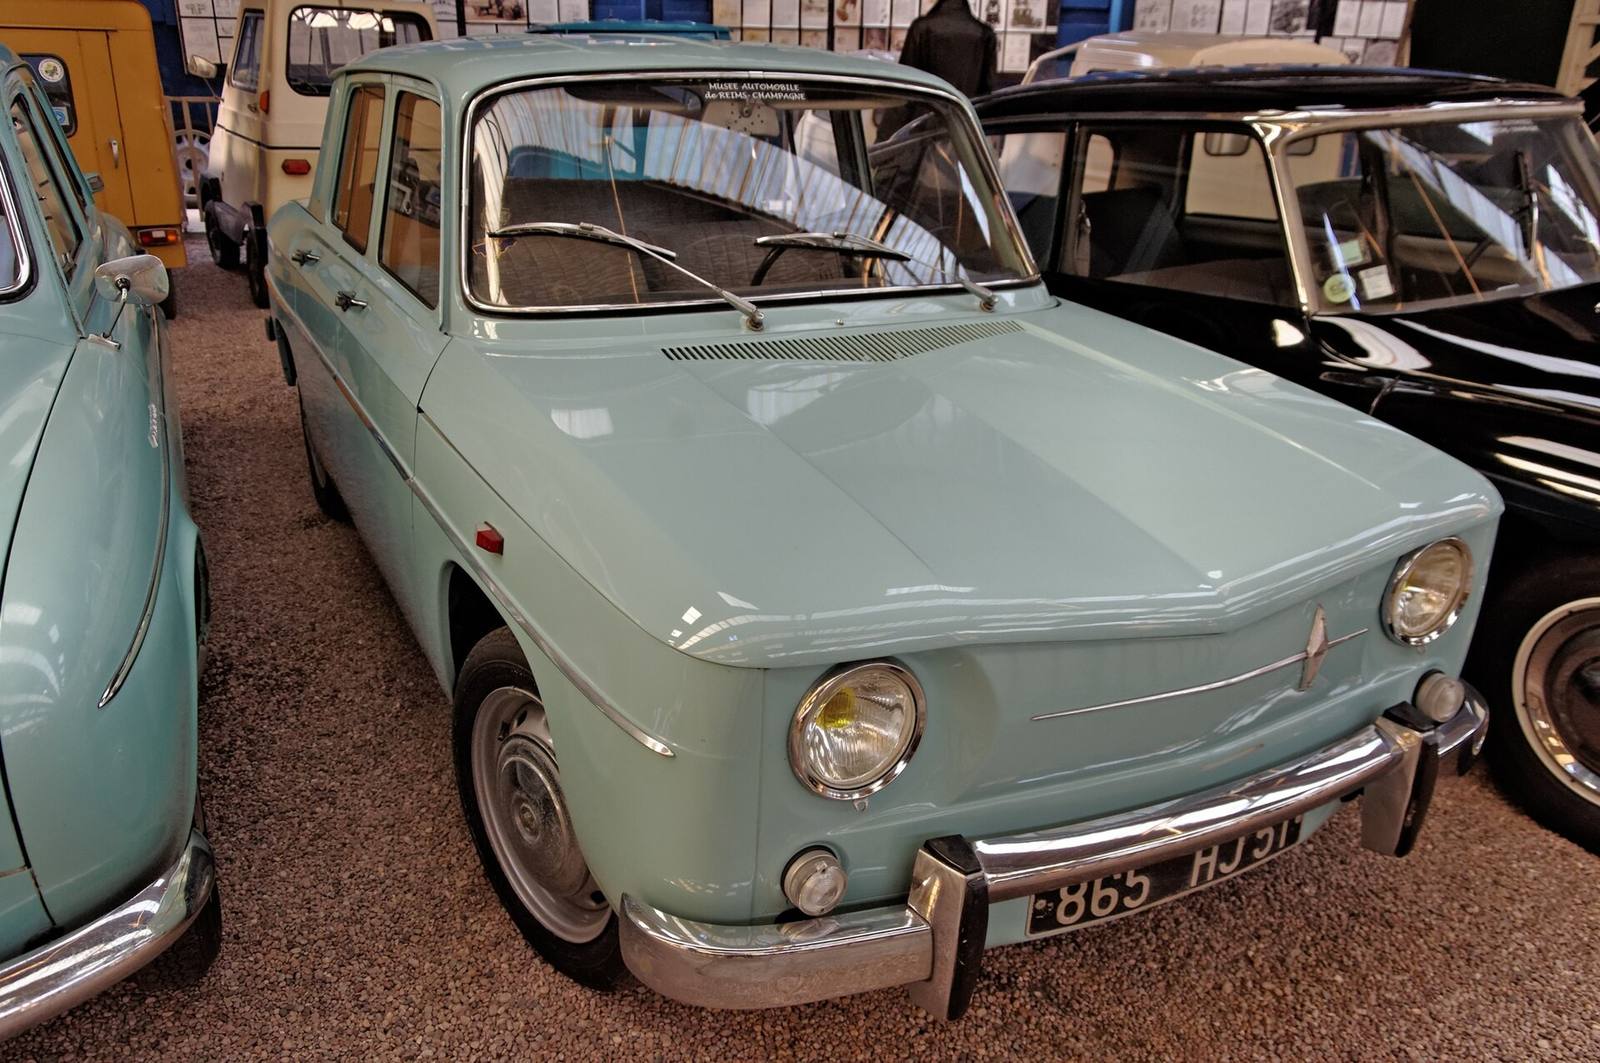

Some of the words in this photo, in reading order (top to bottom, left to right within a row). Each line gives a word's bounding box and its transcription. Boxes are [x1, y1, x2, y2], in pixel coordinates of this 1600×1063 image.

[741, 82, 800, 91] AUTOMOBILE
[1056, 869, 1150, 926] 865
[1190, 836, 1246, 887] HJ
